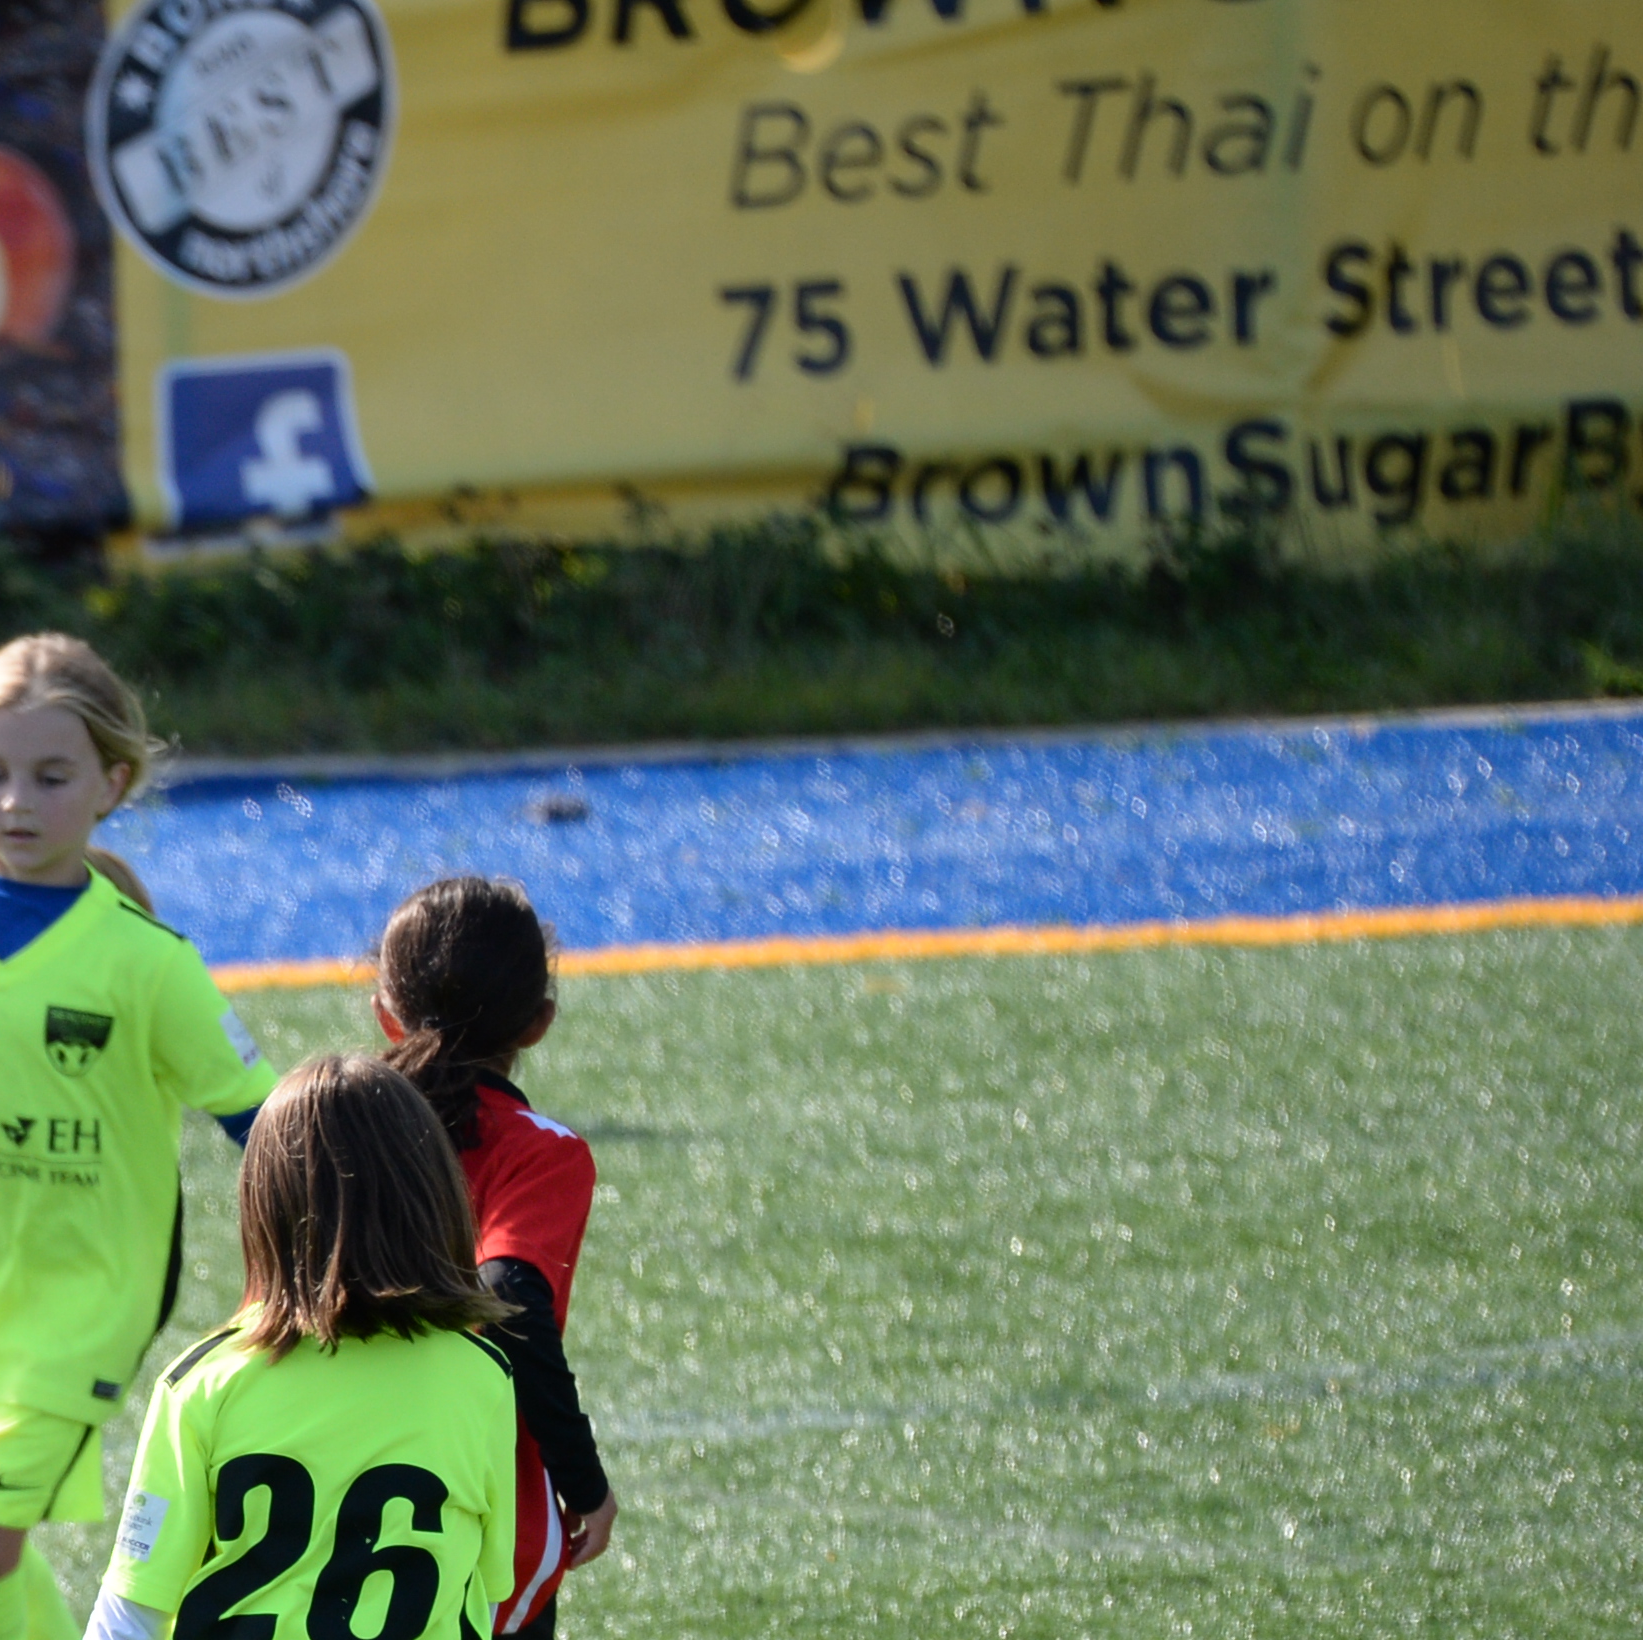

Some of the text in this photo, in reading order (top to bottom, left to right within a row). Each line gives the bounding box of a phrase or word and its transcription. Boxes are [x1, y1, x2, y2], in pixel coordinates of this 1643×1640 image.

[732, 90, 1004, 209] Best
[1055, 63, 1321, 187] Thai
[1350, 79, 1484, 167] on
[719, 225, 1643, 382] 75 Water Street
